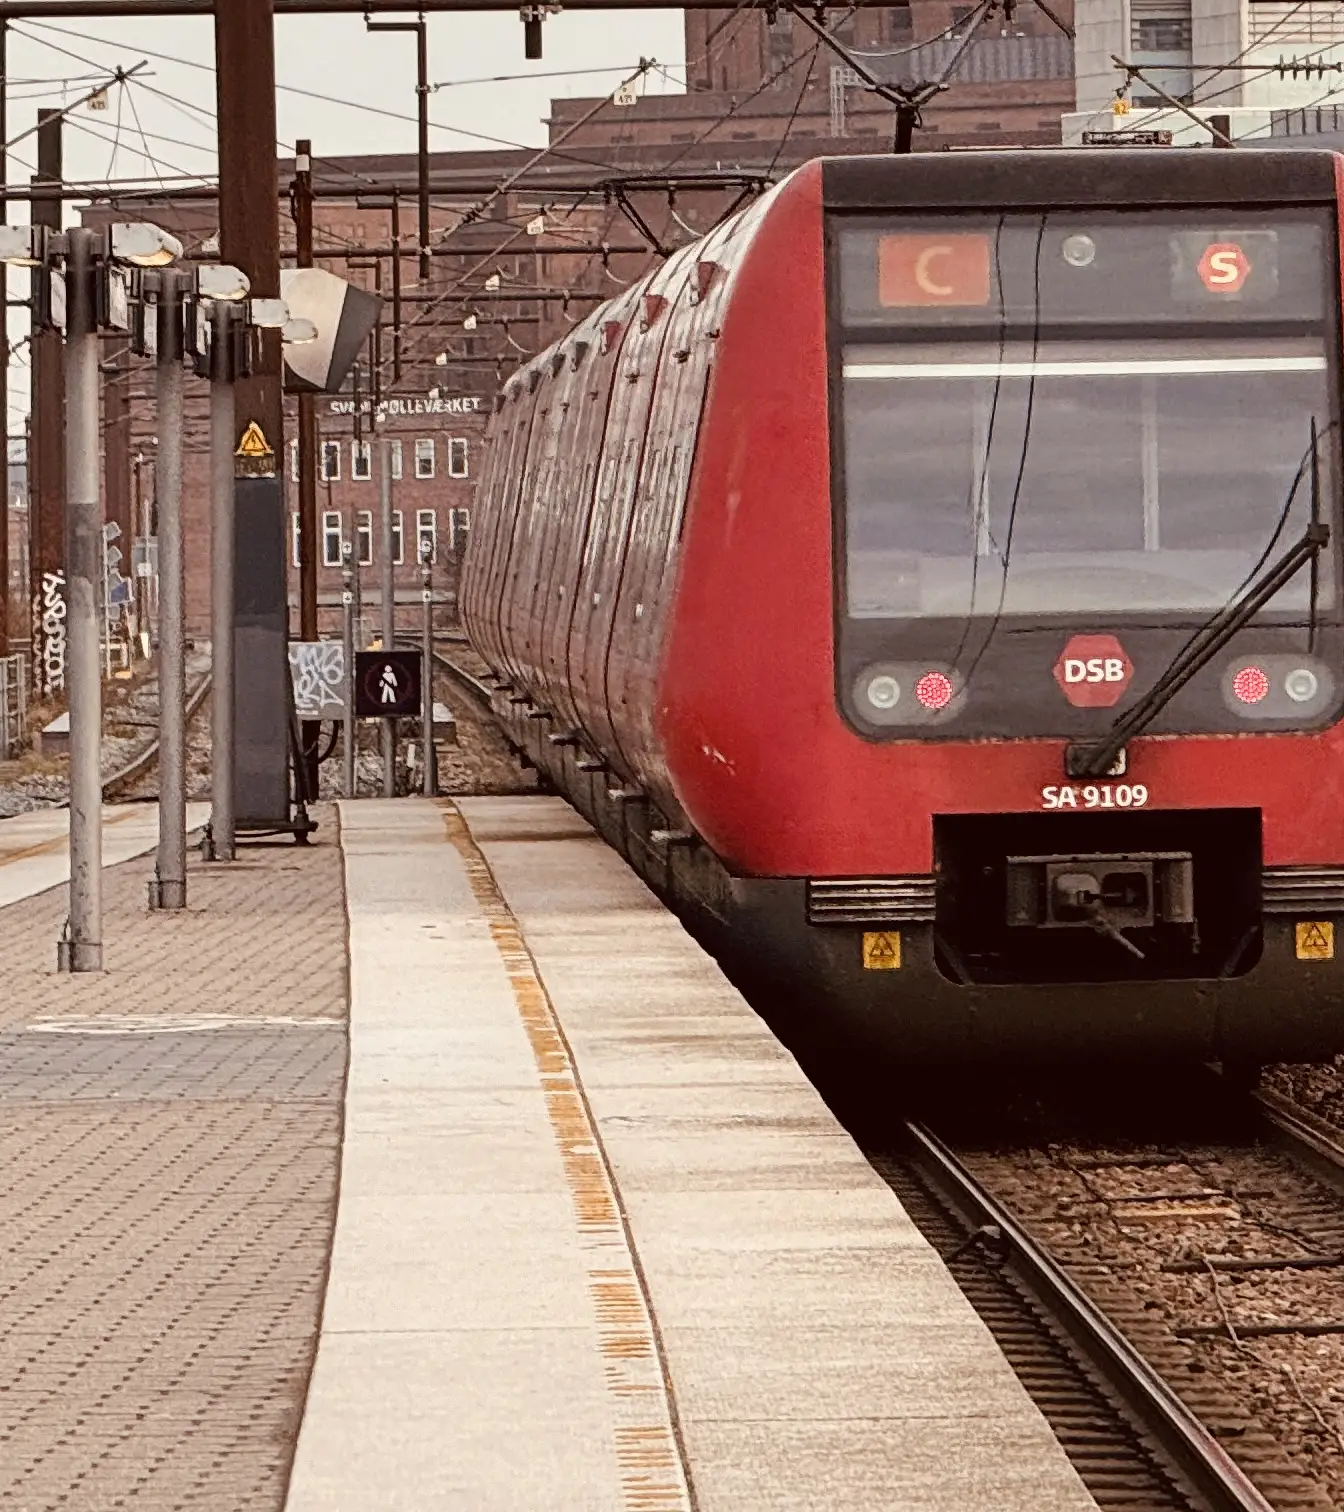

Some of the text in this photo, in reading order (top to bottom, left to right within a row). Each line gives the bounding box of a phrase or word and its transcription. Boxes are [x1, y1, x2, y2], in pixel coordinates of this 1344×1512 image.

[915, 245, 953, 296] C
[1209, 251, 1239, 284] S
[1064, 658, 1124, 684] DSB
[1042, 784, 1148, 809] SA 9109
